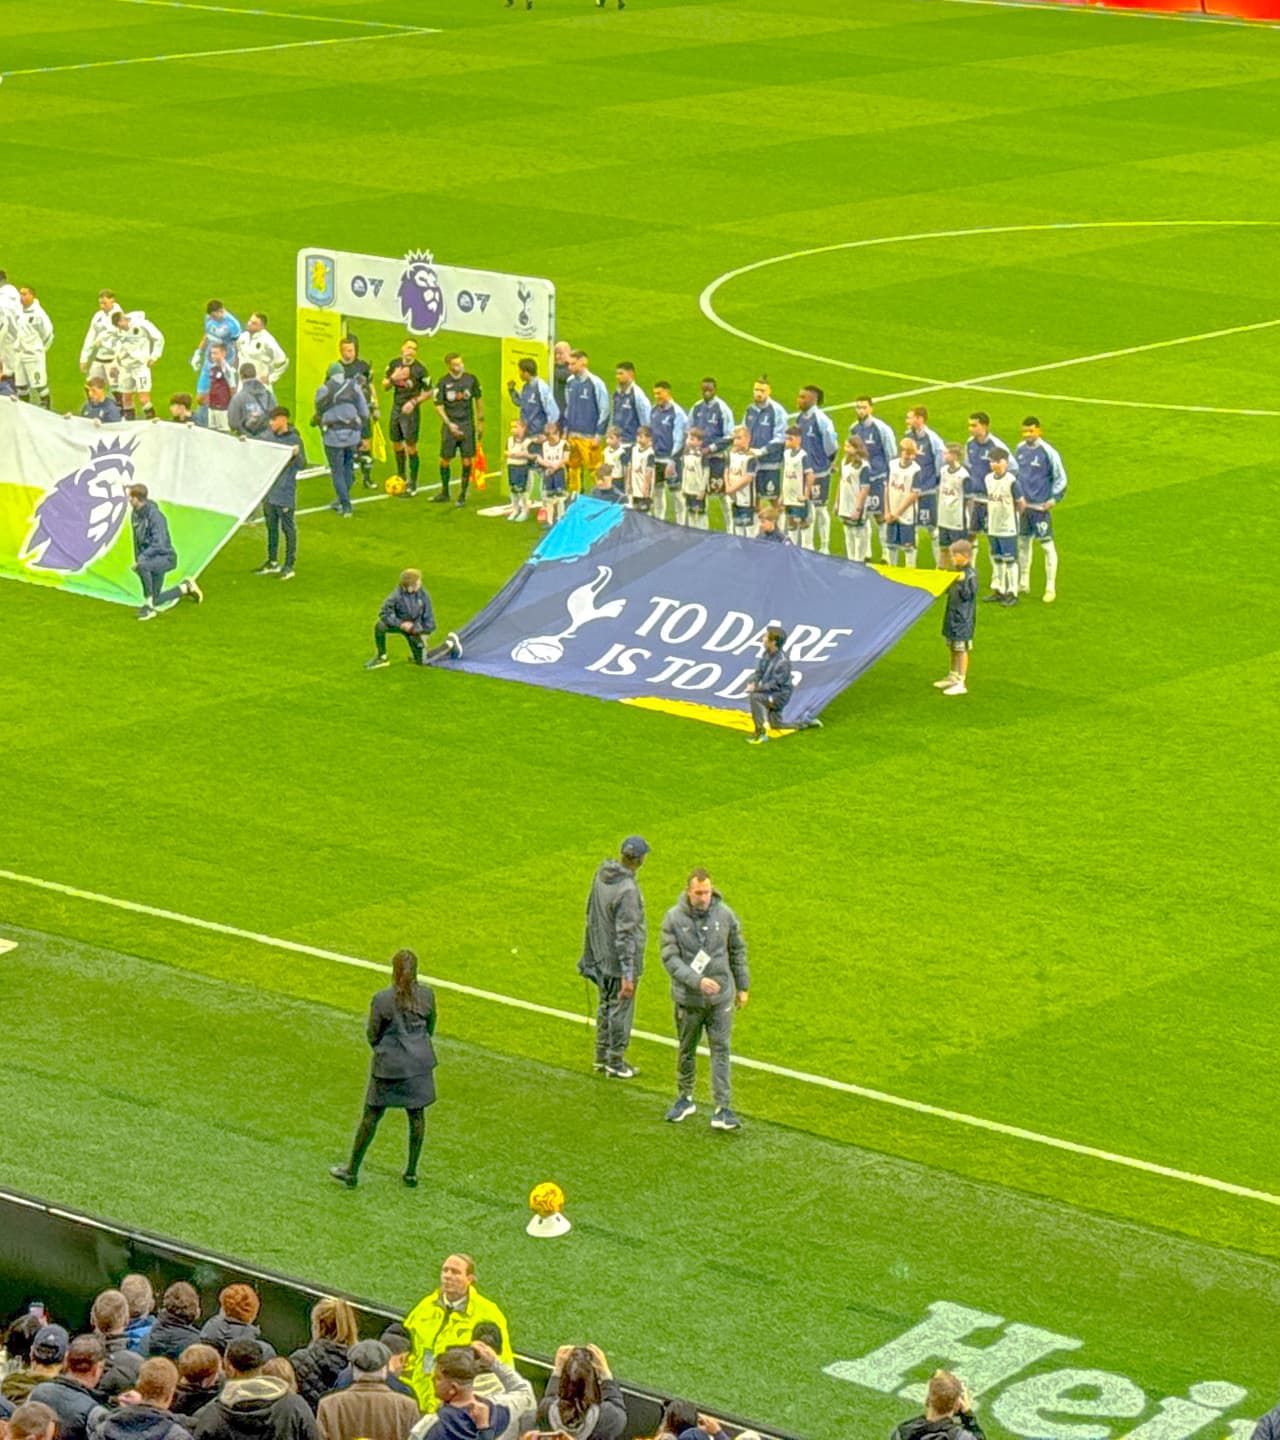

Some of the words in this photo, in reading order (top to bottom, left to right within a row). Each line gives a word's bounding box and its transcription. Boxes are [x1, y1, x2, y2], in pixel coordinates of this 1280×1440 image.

[919, 509, 930, 521] 21
[635, 596, 708, 644] TO
[585, 643, 652, 675] IS
[646, 656, 721, 690] TO
